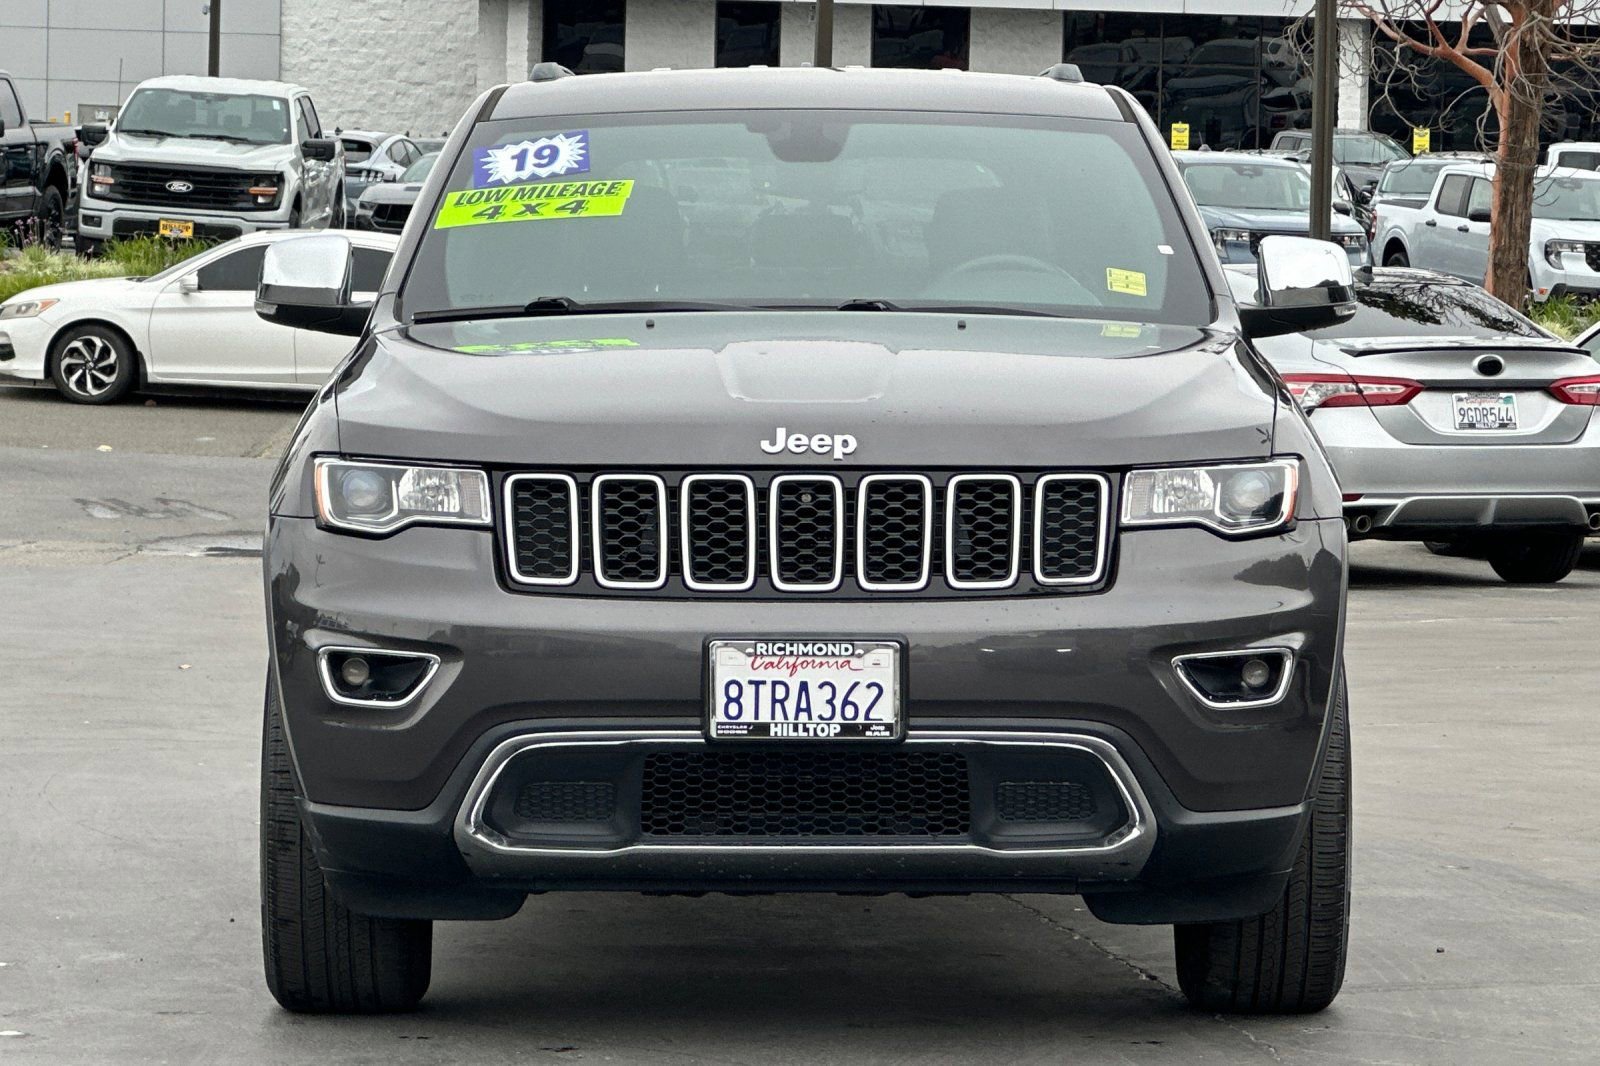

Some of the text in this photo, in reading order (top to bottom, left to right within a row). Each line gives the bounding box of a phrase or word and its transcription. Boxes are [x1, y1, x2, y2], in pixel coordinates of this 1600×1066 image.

[510, 143, 561, 172] 19
[453, 181, 627, 208] LOW MILEAGE
[1458, 407, 1513, 423] 9GDR544
[760, 427, 858, 460] Jeep
[756, 643, 854, 656] RICHMOND
[751, 655, 864, 677] California
[723, 679, 884, 721] 8TRA362
[769, 723, 841, 737] HILLTOP
